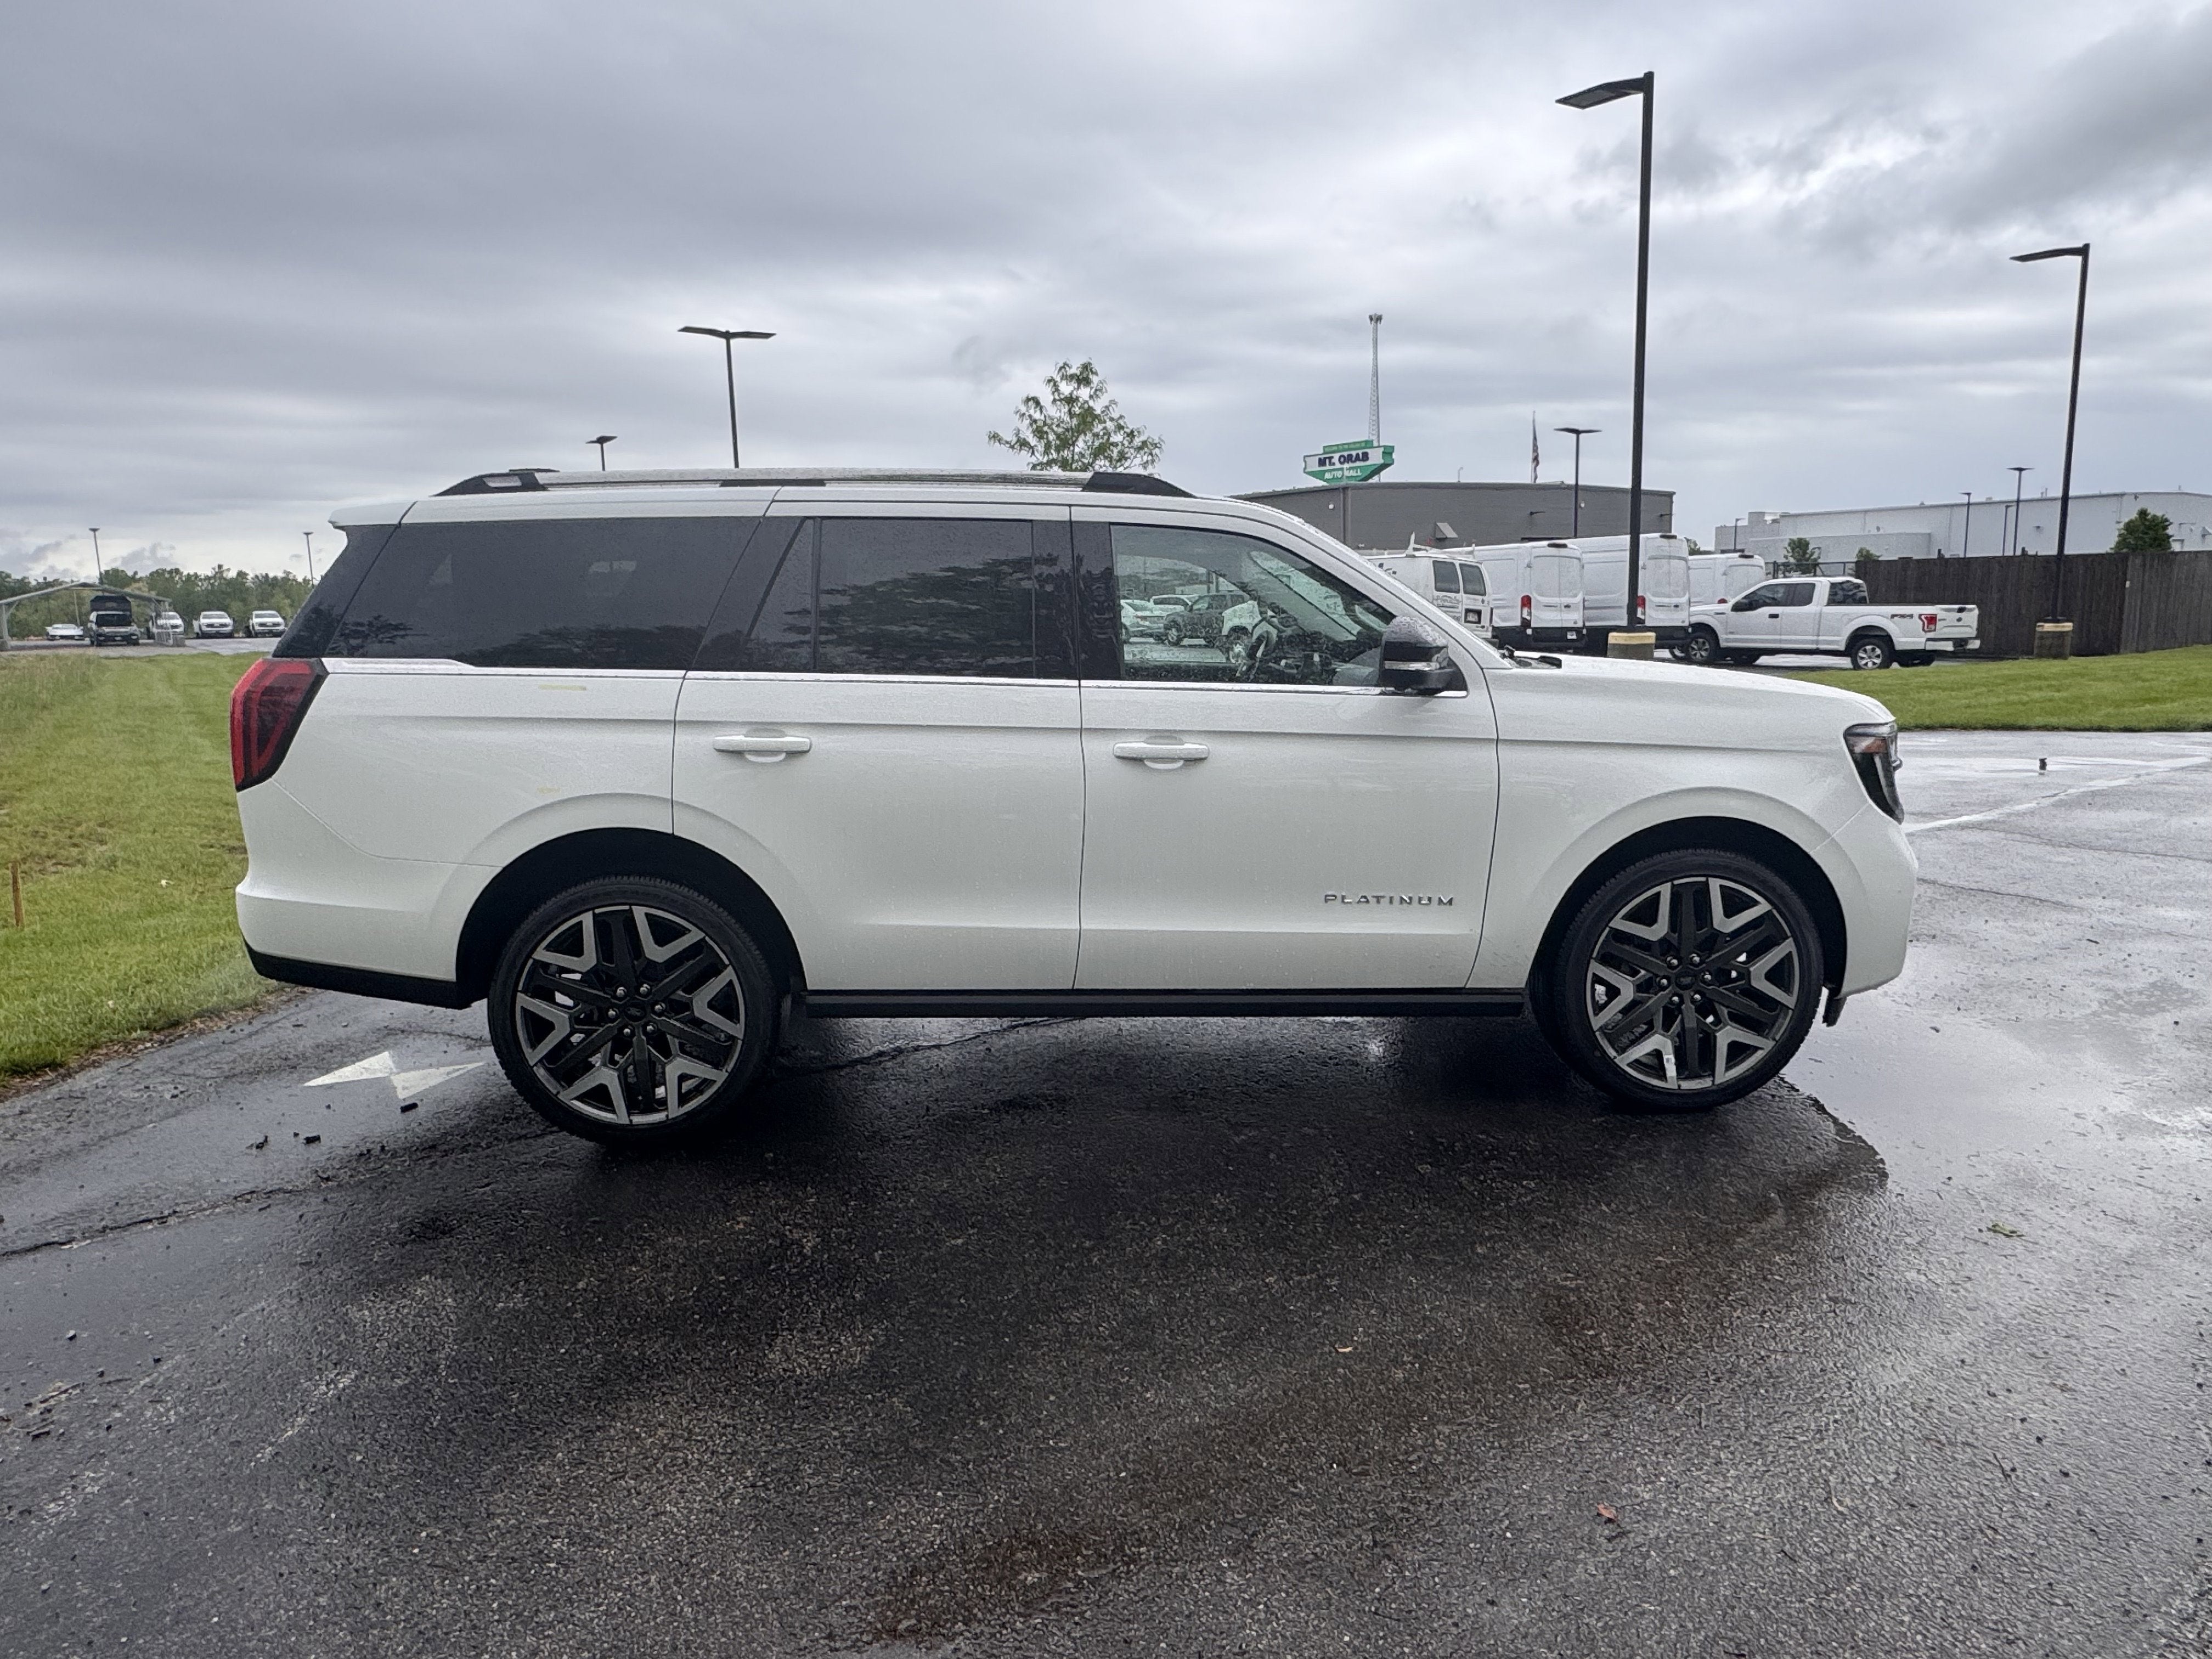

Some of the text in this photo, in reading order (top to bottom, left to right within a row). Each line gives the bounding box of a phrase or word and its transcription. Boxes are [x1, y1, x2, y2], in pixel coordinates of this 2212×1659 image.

[1318, 452, 1369, 466] MT. ORAB
[1325, 471, 1343, 479] AUTO
[1324, 893, 1454, 906] PLATINUM
